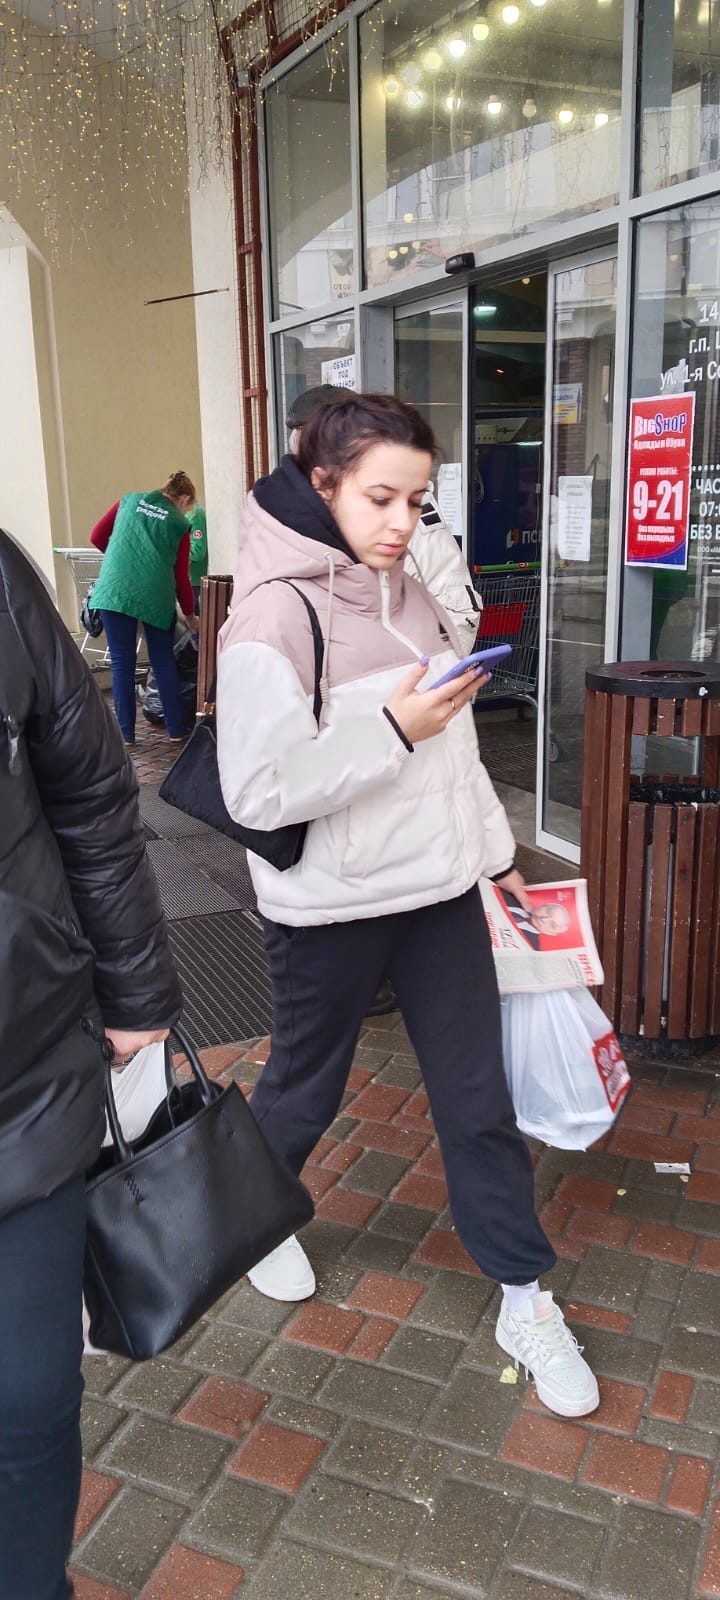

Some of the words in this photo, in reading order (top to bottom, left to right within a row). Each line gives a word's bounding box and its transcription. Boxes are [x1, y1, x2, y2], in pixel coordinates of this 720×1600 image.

[689, 337, 710, 354] г.п.
[661, 372, 677, 391] ул.
[683, 364, 703, 383] 1-я
[633, 480, 684, 520] 9-21
[699, 501, 720, 517] 07:
[691, 524, 712, 540] БЕЗ
